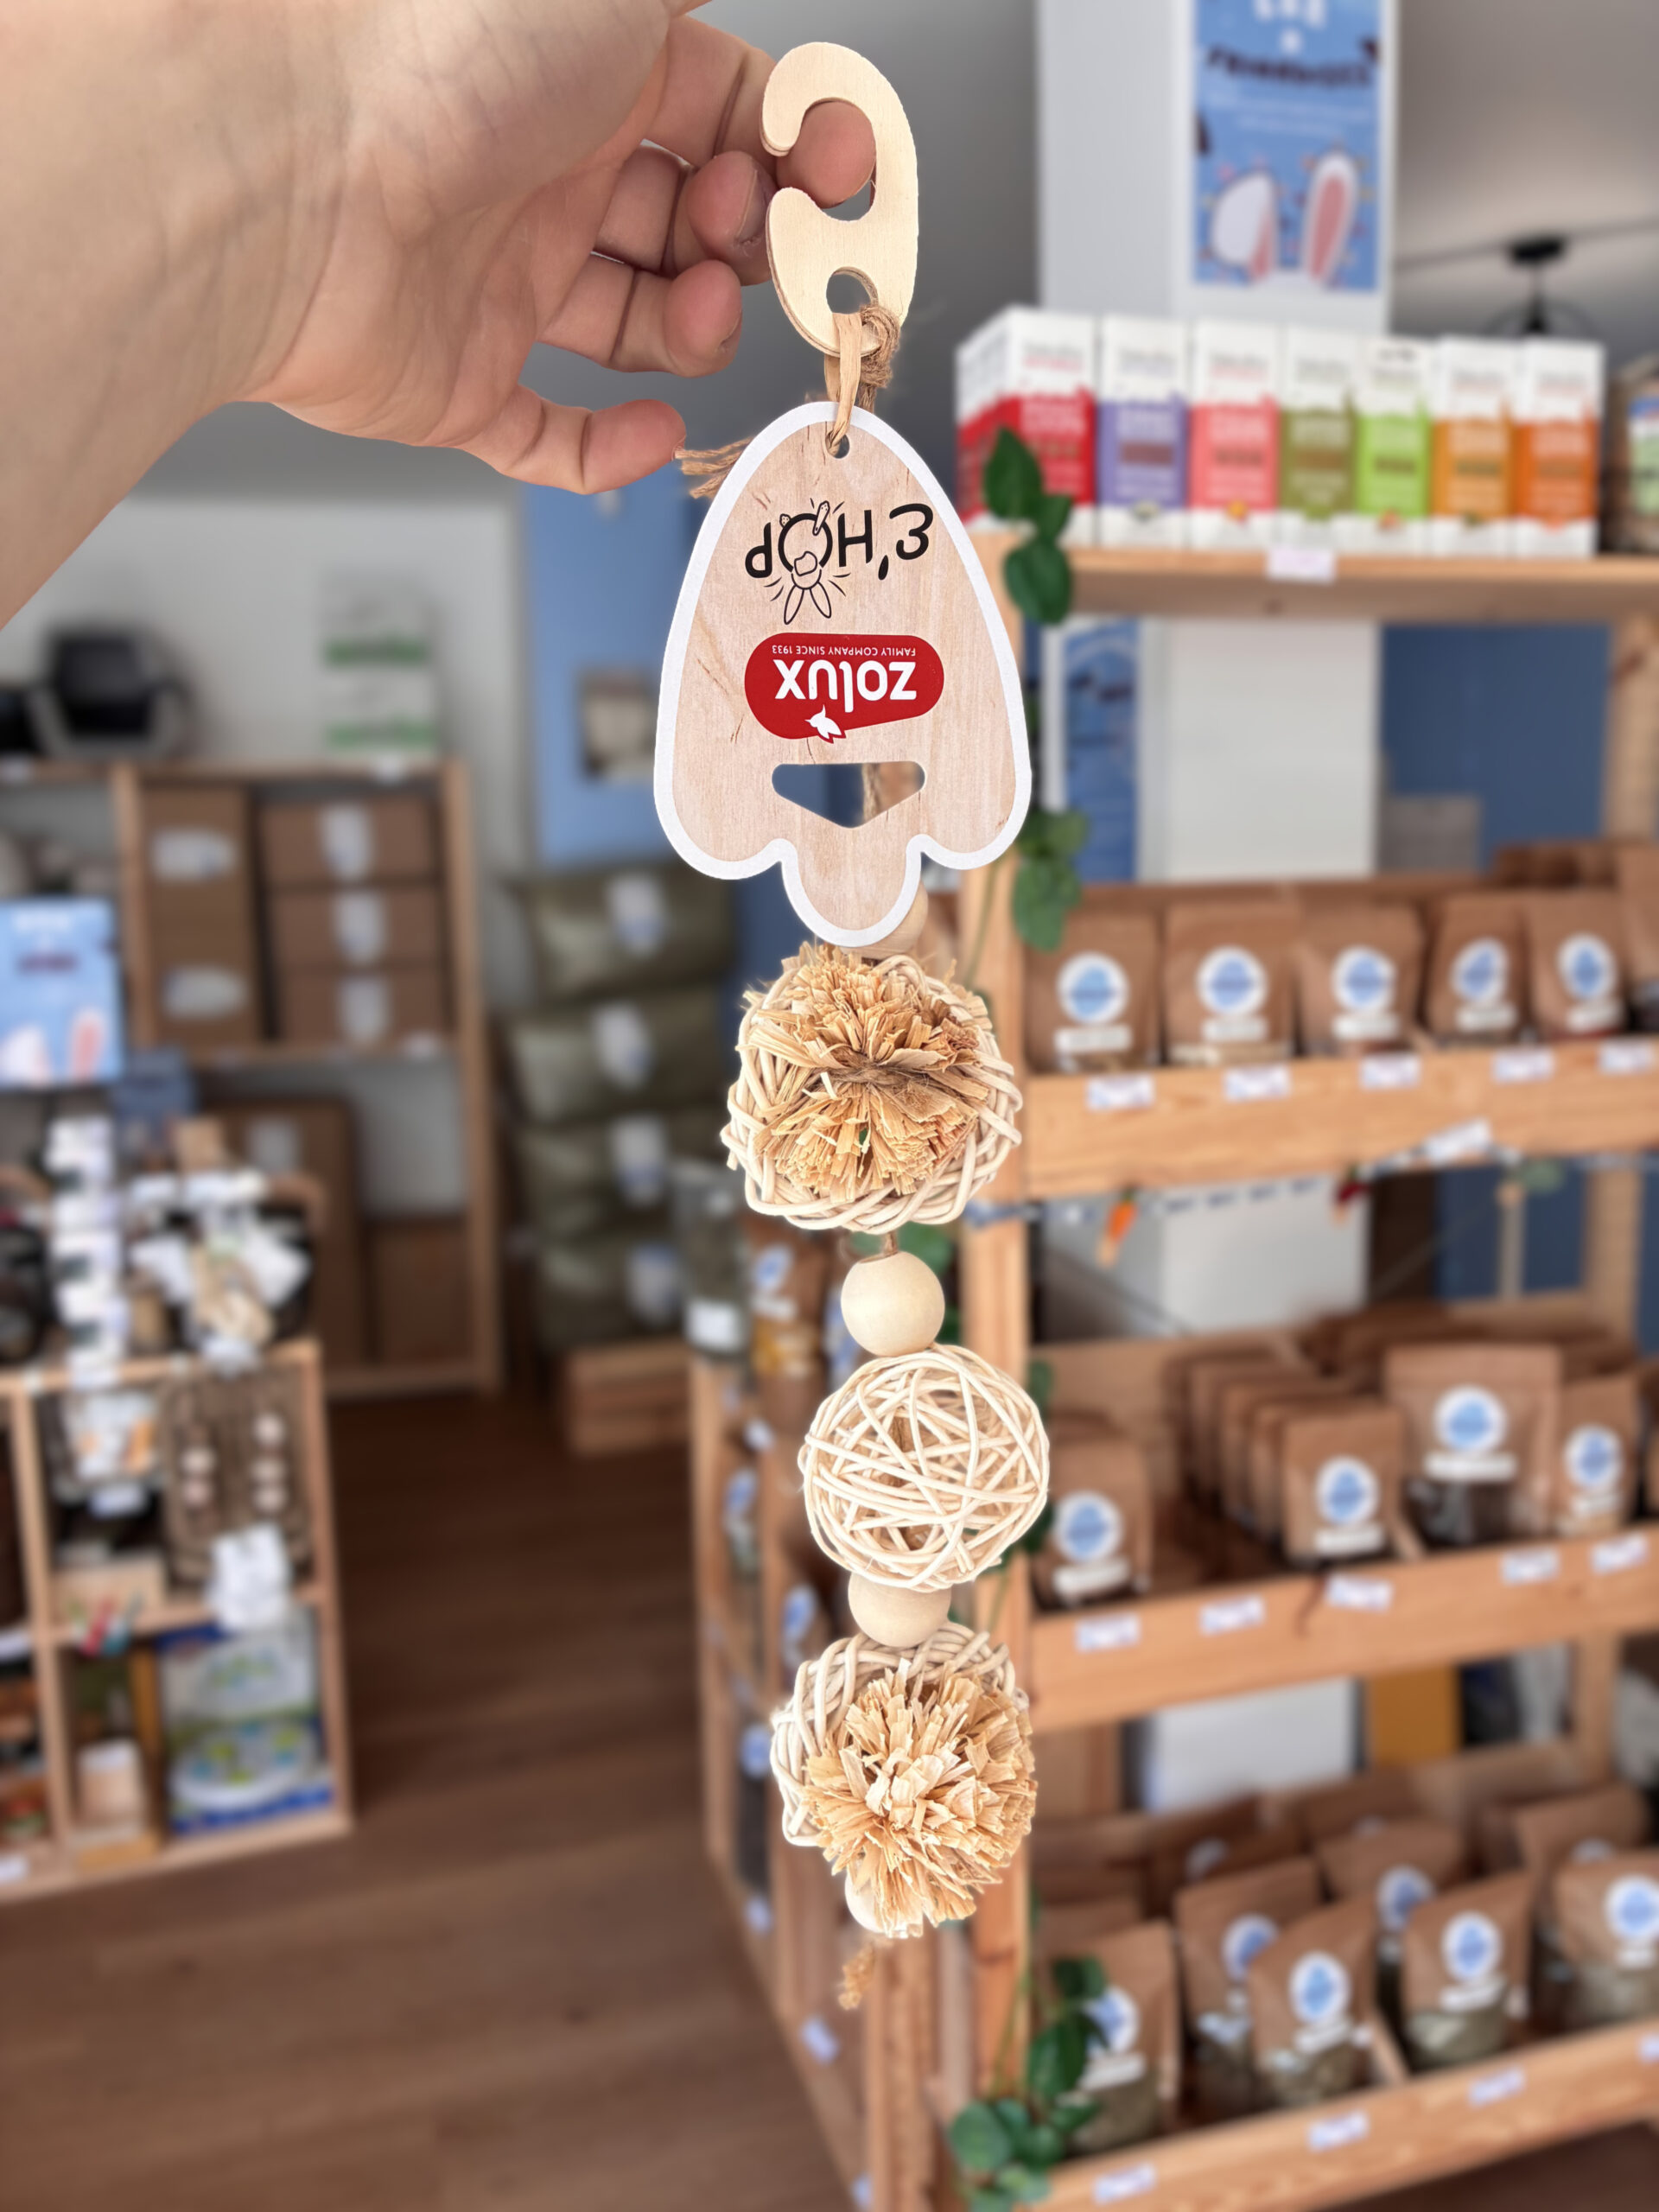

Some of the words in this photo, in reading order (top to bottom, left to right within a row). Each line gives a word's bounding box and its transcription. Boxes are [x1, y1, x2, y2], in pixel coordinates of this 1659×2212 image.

[772, 645, 793, 655] 1933
[796, 645, 825, 656] SINCE
[828, 645, 879, 656] COMPANY
[881, 646, 916, 657] FAMILY
